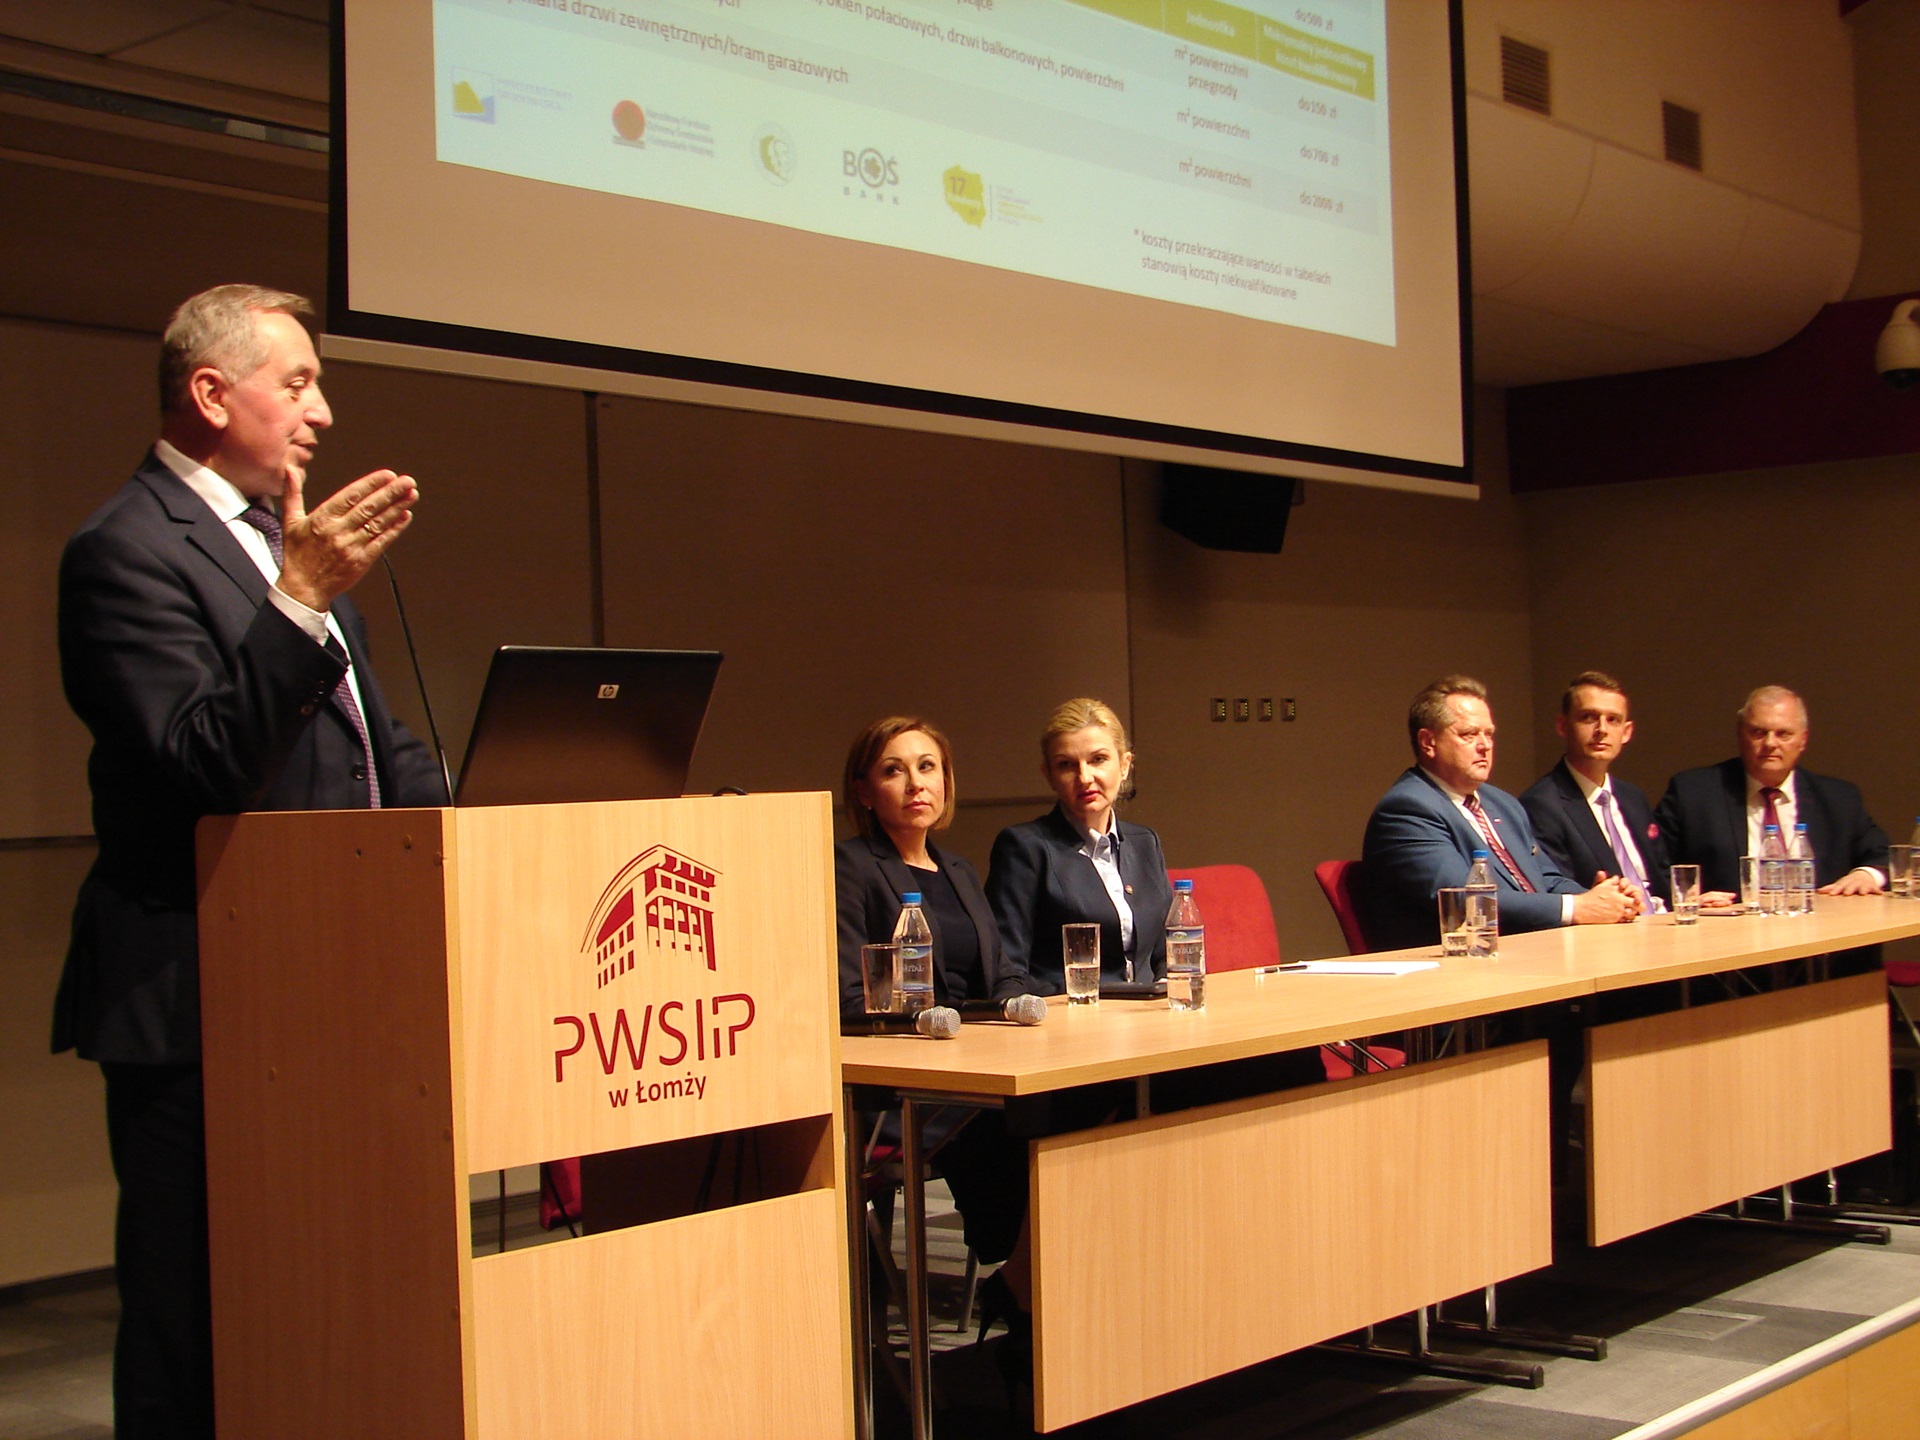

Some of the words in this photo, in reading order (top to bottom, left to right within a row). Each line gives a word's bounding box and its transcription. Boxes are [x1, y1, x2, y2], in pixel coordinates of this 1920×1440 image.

[570, 0, 616, 23] drzwi
[767, 53, 849, 83] garażowych
[947, 28, 980, 49] drzwi
[981, 37, 1058, 74] balkonowych,
[1060, 64, 1125, 91] powierzchni
[1192, 115, 1250, 140] powierzchni
[949, 175, 967, 198] 17
[1194, 165, 1252, 189] powierzchni
[1141, 231, 1174, 253] koszty
[1174, 242, 1245, 267] przekraczające
[1283, 265, 1293, 277] w
[1294, 266, 1332, 286] tabelach
[1141, 256, 1188, 280] stanowią
[1188, 264, 1220, 286] koszty
[608, 1088, 629, 1109] w
[635, 1071, 707, 1105] Łomży
